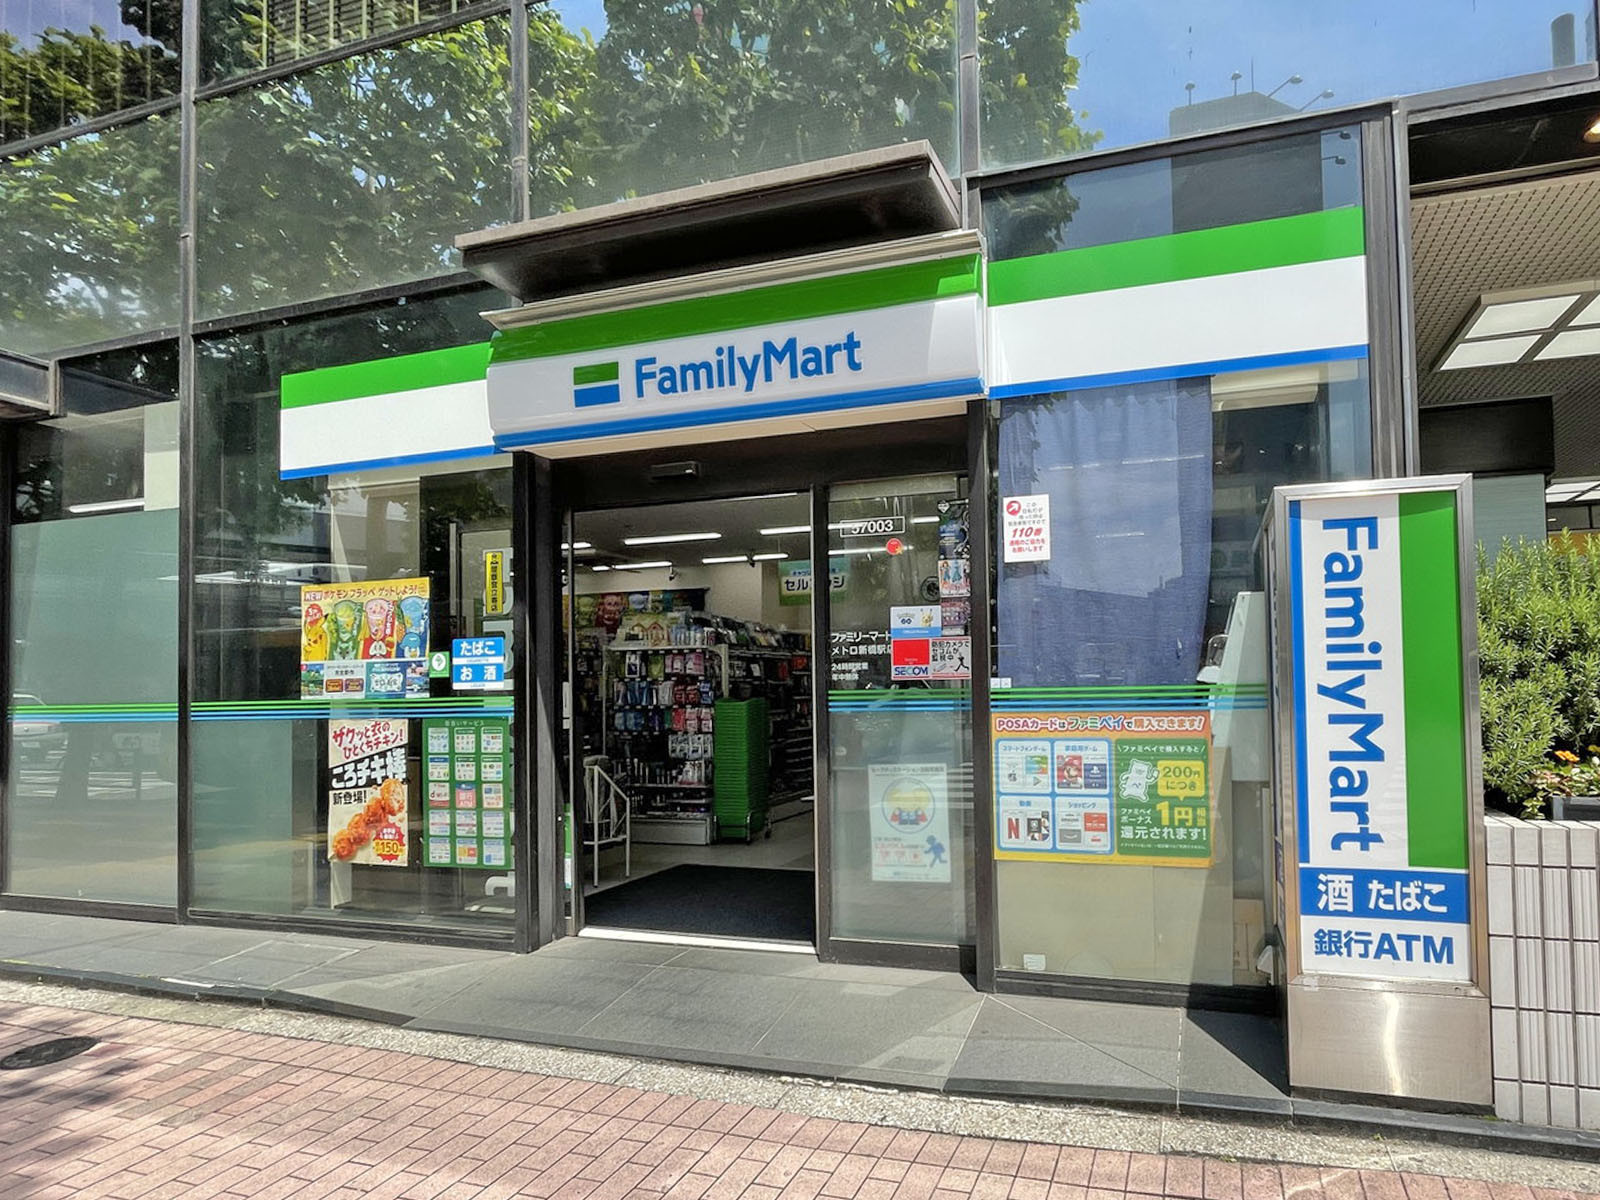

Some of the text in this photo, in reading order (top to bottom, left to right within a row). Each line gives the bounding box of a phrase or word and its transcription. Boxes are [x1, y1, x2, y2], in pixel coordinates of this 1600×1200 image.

[635, 331, 862, 398] FamilyMart
[460, 641, 496, 656] たばこ
[894, 666, 928, 675] SECOM
[1317, 516, 1385, 852] FamilyMart
[332, 747, 406, 788] ころチキ棒
[1163, 766, 1200, 778] 200円
[1166, 780, 1197, 791] につき
[333, 790, 367, 805] 新登場!
[1120, 826, 1207, 841] 還元されます!
[1317, 873, 1448, 913] 酒 たばこ
[1313, 928, 1454, 965] 銀行ATM
